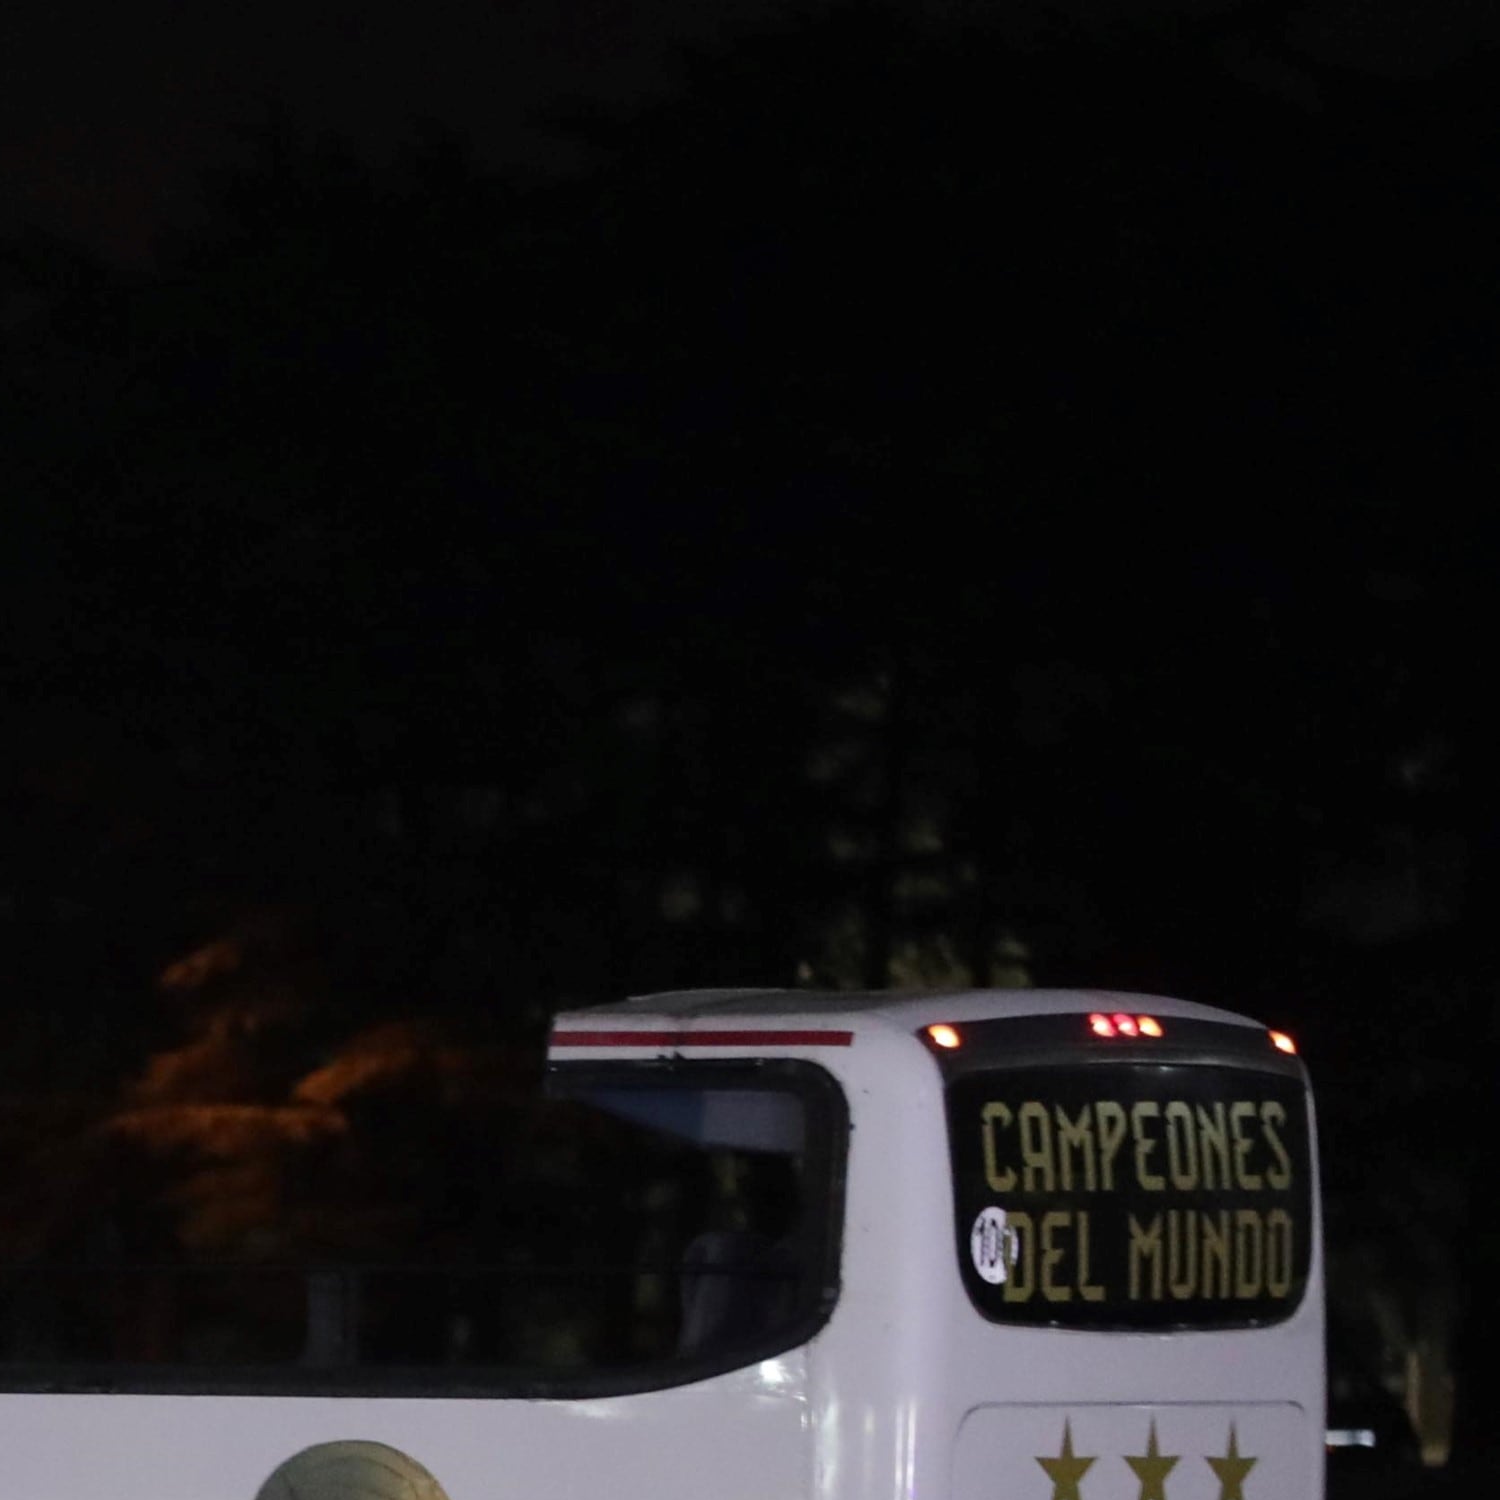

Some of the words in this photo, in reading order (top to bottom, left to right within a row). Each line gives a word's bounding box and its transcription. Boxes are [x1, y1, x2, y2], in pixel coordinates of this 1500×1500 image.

[981, 1101, 1292, 1192] CAMPEONES
[1003, 1210, 1105, 1303] DEL
[1127, 1208, 1293, 1300] MUNDO
